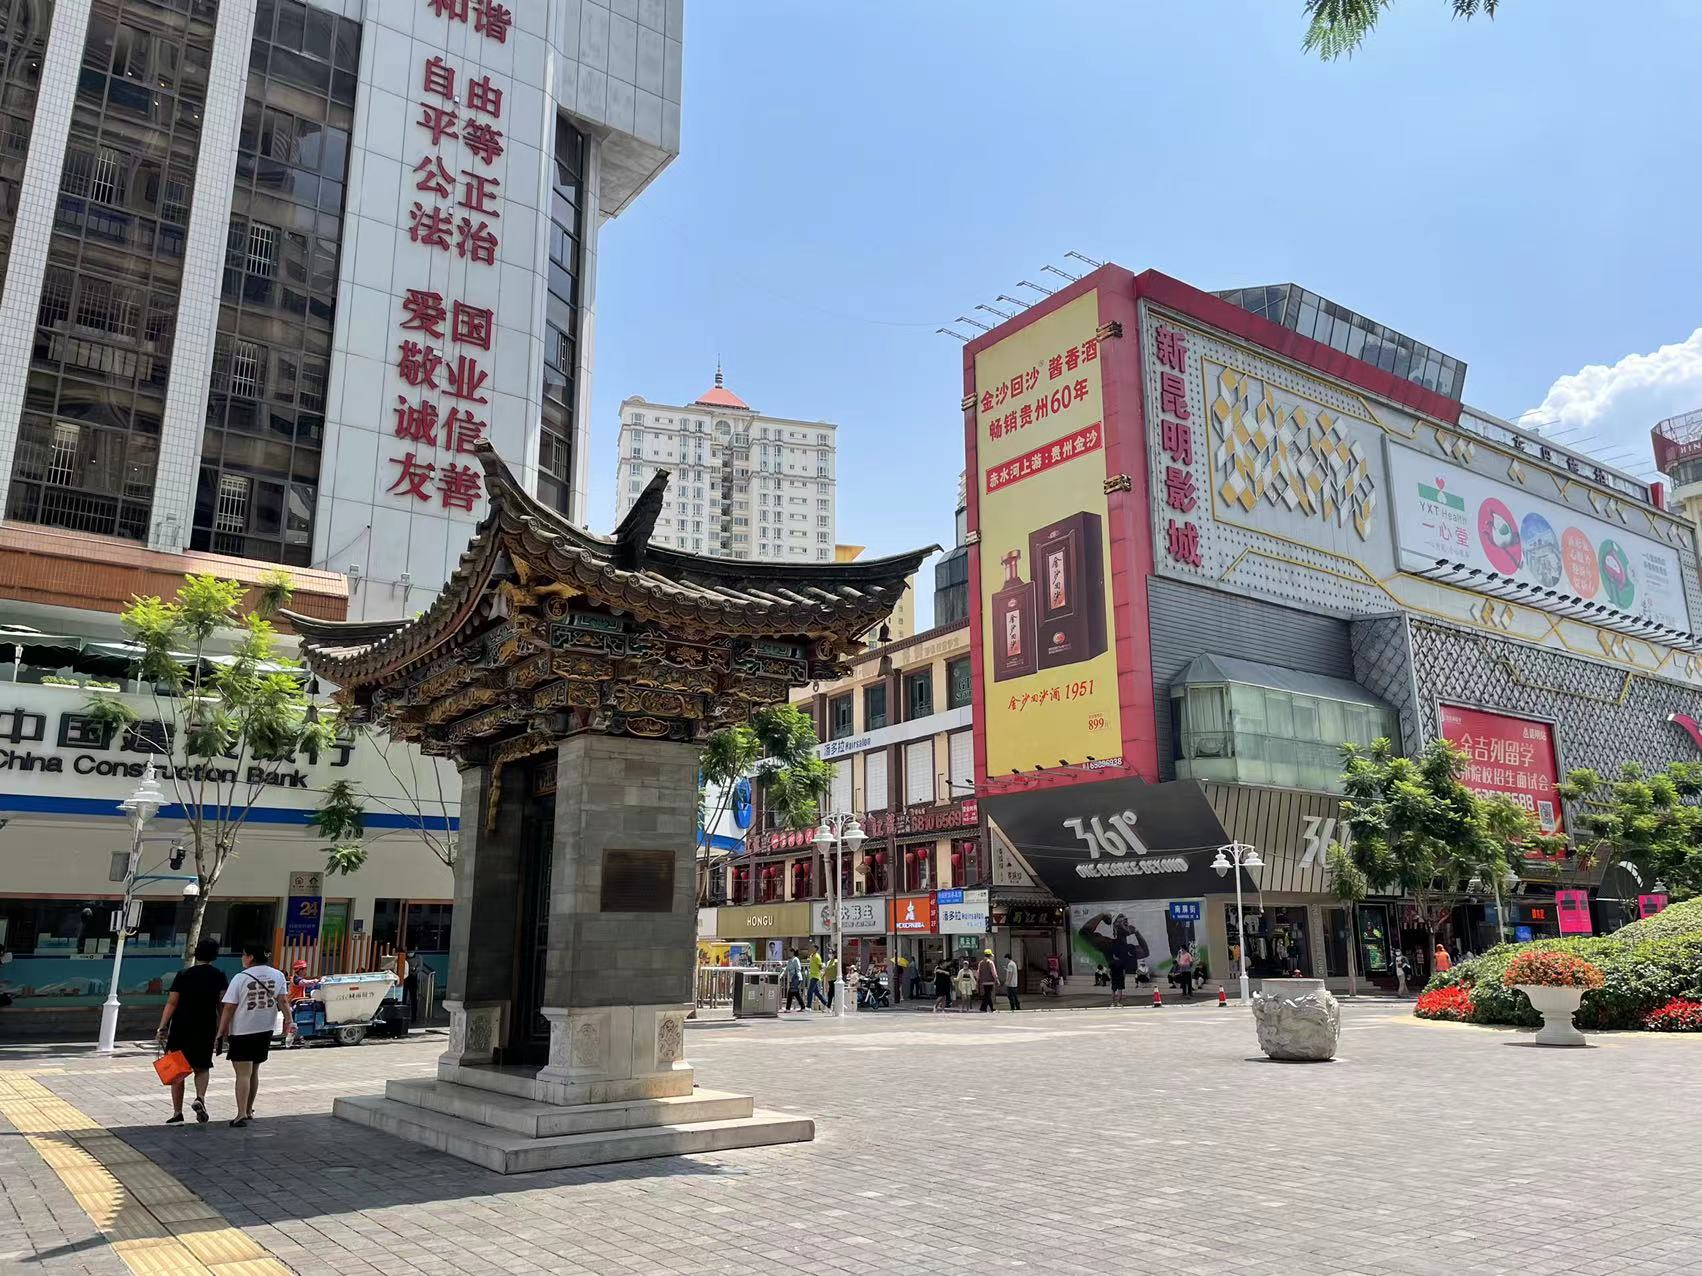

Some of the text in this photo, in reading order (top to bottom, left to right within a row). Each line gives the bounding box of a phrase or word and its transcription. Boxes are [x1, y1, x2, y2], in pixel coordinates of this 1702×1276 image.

[424, 56, 502, 118] 自由
[416, 102, 504, 166] 平等
[413, 156, 500, 217] 公正
[409, 202, 498, 265] 法治
[400, 289, 493, 351] 爱国
[398, 340, 488, 404] 敬业
[981, 339, 1098, 413] 金沙回沙 酱香酒
[394, 395, 487, 453] 诚信
[989, 378, 1088, 442] 畅销贵州60年
[1156, 326, 1202, 568] 新昆明影城
[387, 452, 481, 511] 友善
[1420, 501, 1467, 525] YXT Health
[1422, 521, 1469, 547] 一心堂
[1065, 680, 1094, 701] 1951
[0, 707, 355, 767] 中国建
[1088, 718, 1105, 730] 899
[1461, 733, 1534, 767] 金吉列留学
[248, 766, 308, 789] Bank
[1075, 858, 1189, 878] ONE DEGREE BEYOND
[747, 915, 773, 926] HONGU
